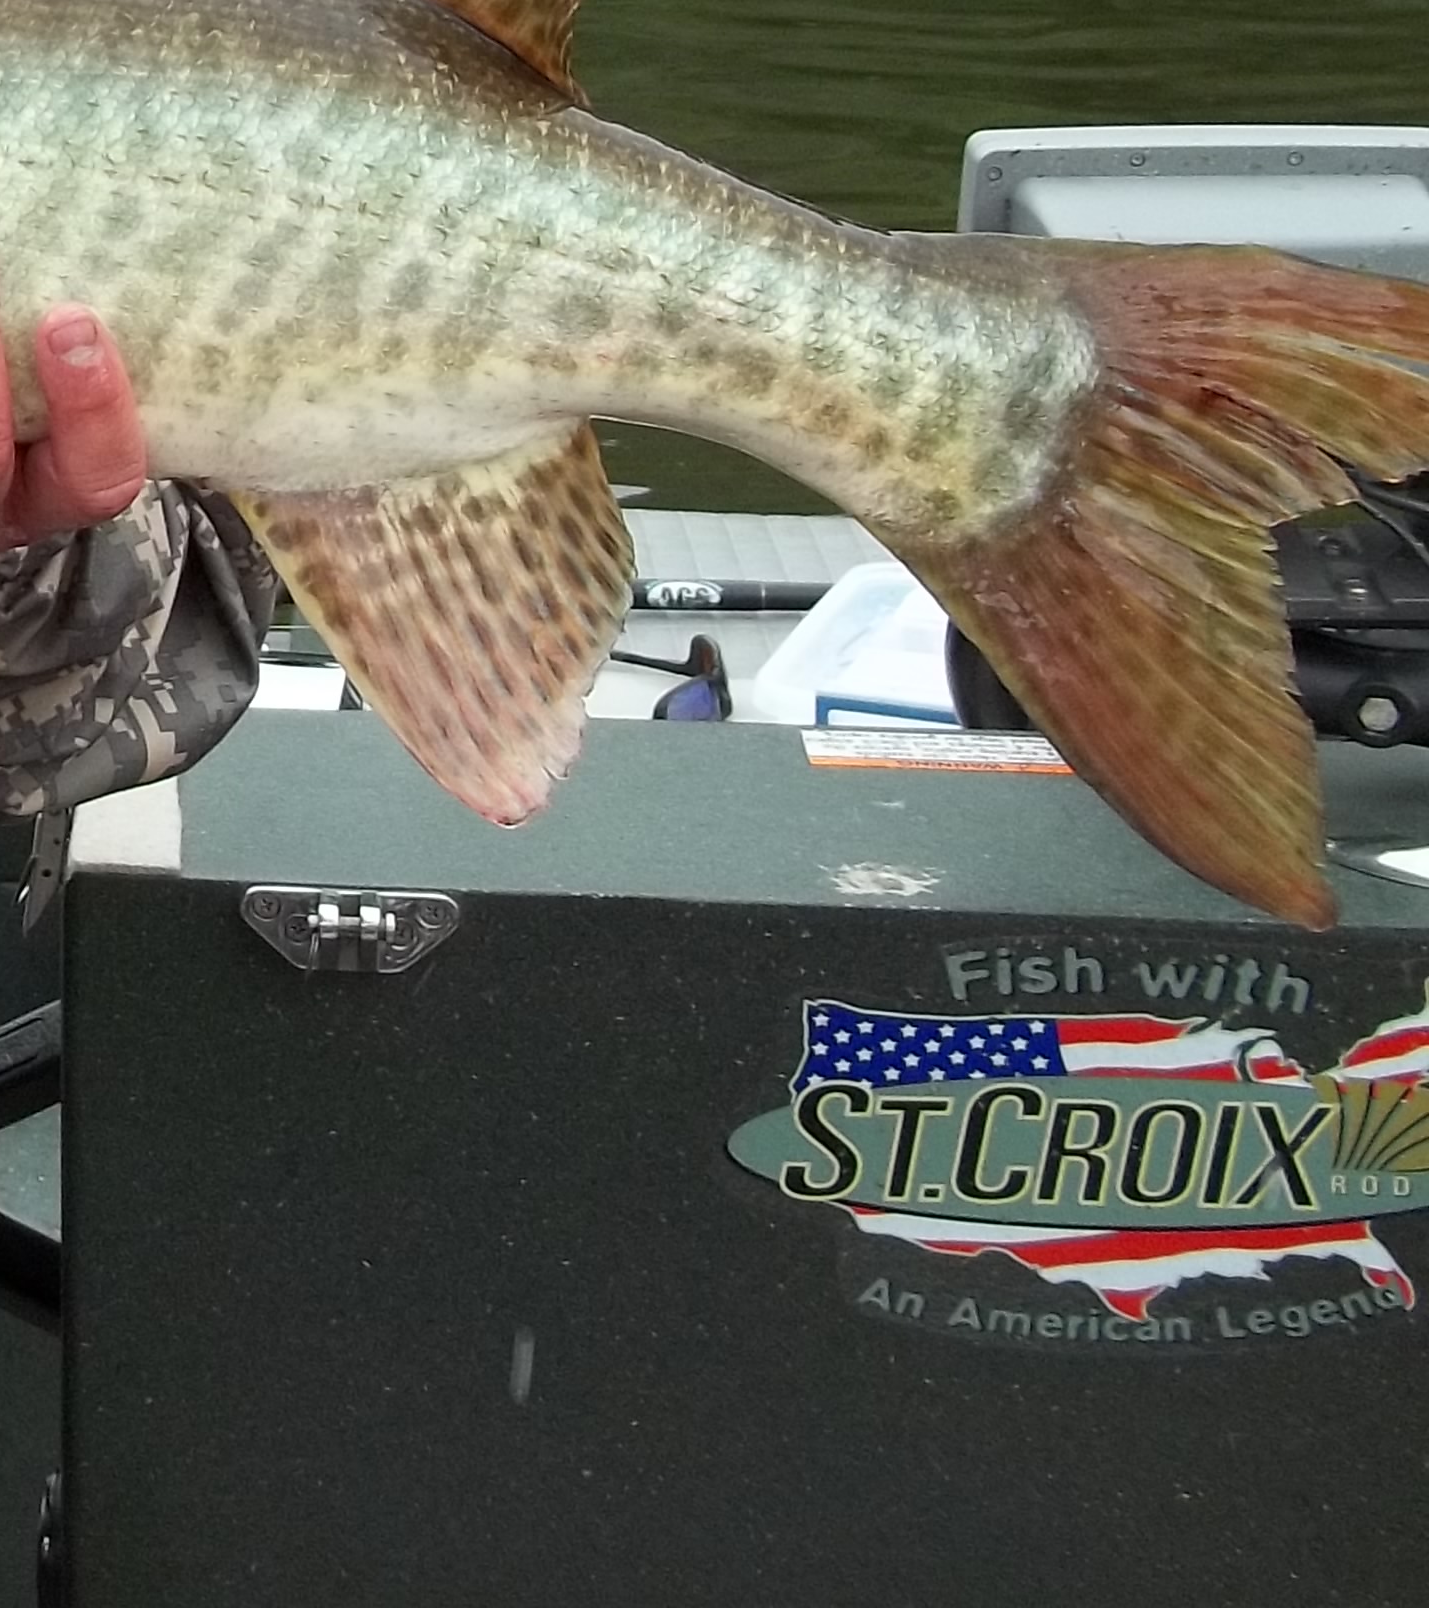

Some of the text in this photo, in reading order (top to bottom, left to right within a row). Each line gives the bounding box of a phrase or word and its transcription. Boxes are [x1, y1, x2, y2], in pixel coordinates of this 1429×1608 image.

[946, 947, 1311, 1014] Fish with
[858, 1277, 1409, 1343] An American Legend
